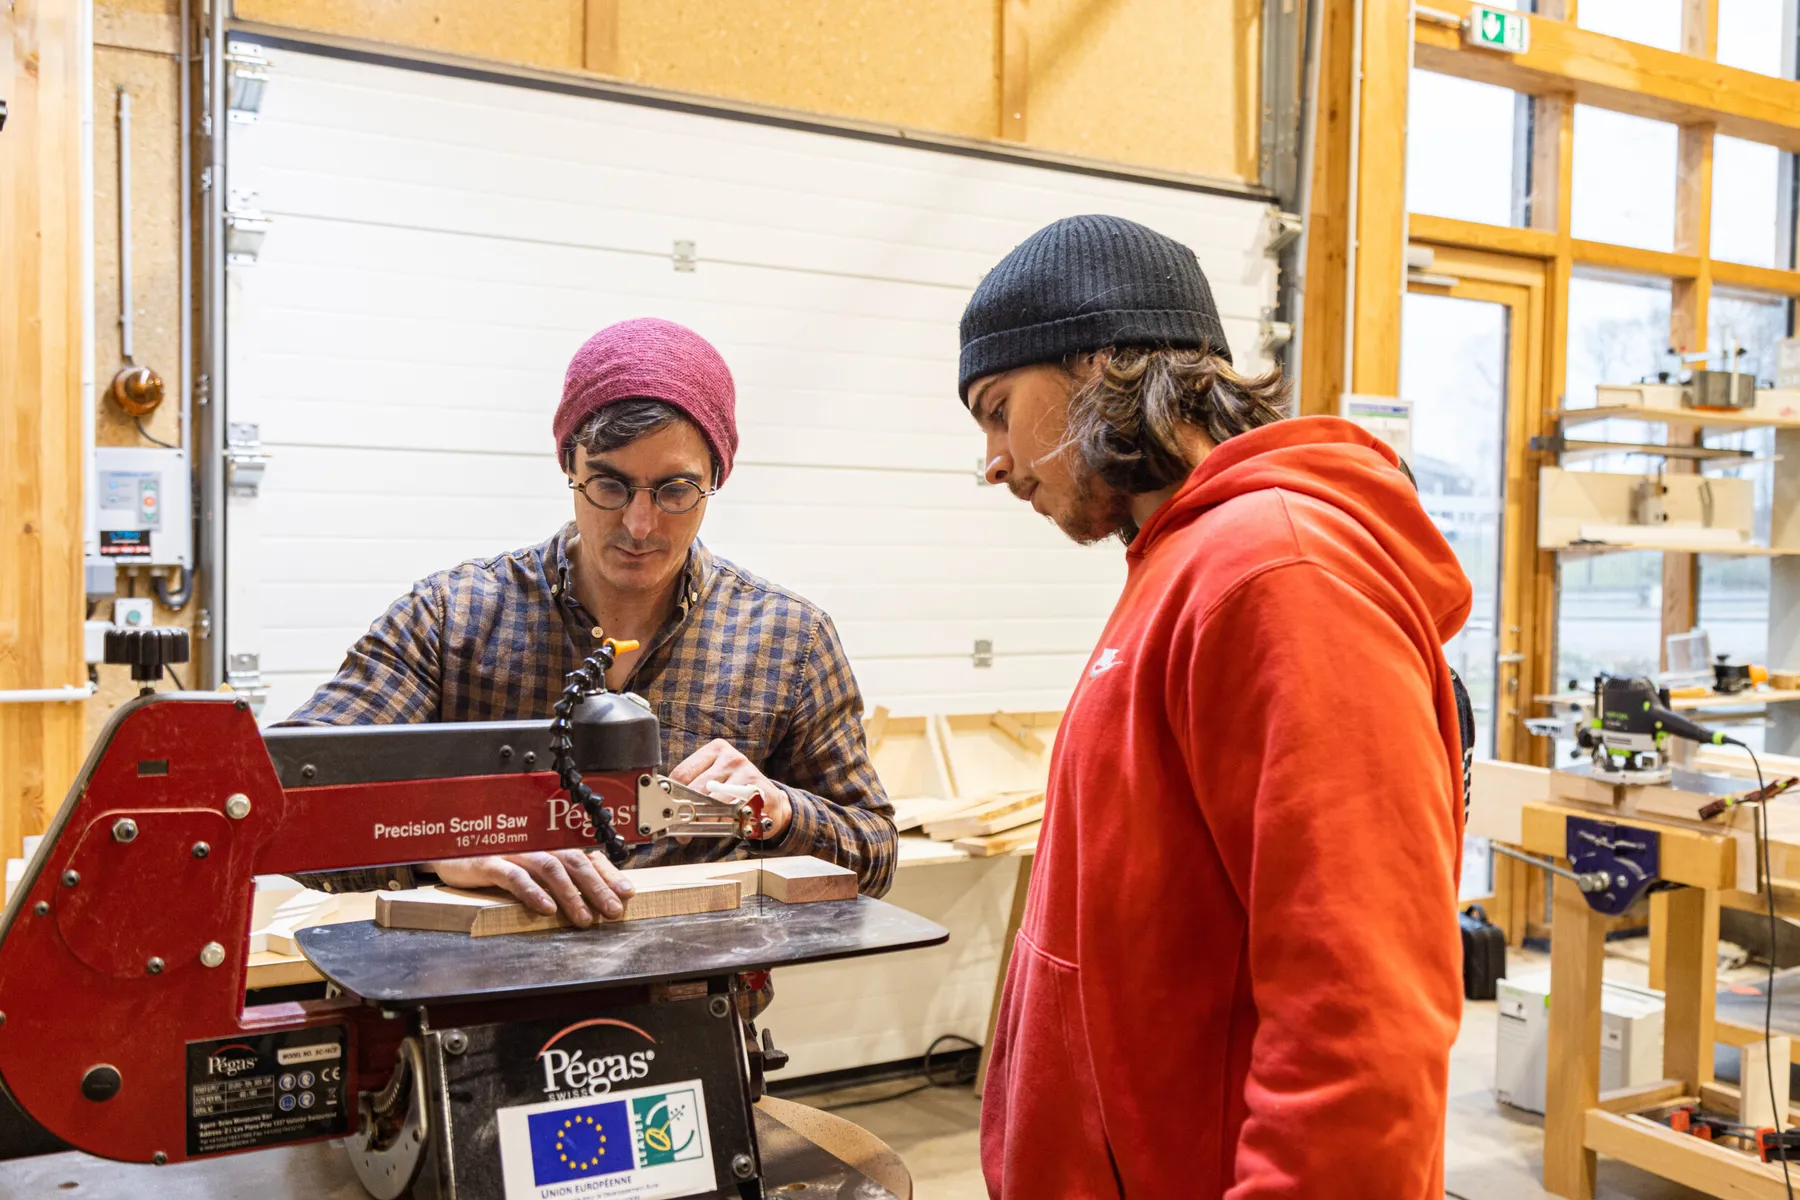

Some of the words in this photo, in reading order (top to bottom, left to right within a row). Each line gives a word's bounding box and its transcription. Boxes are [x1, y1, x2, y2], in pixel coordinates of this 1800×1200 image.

[374, 820, 445, 839] Precision
[450, 815, 492, 833] Scroll
[496, 814, 528, 829] Saw
[208, 1056, 255, 1076] Pégas
[548, 1088, 589, 1102] SWISS
[633, 1112, 648, 1167] LEADER
[541, 1187, 573, 1200] UNION
[575, 1176, 632, 1193] EUROPÉENNE
